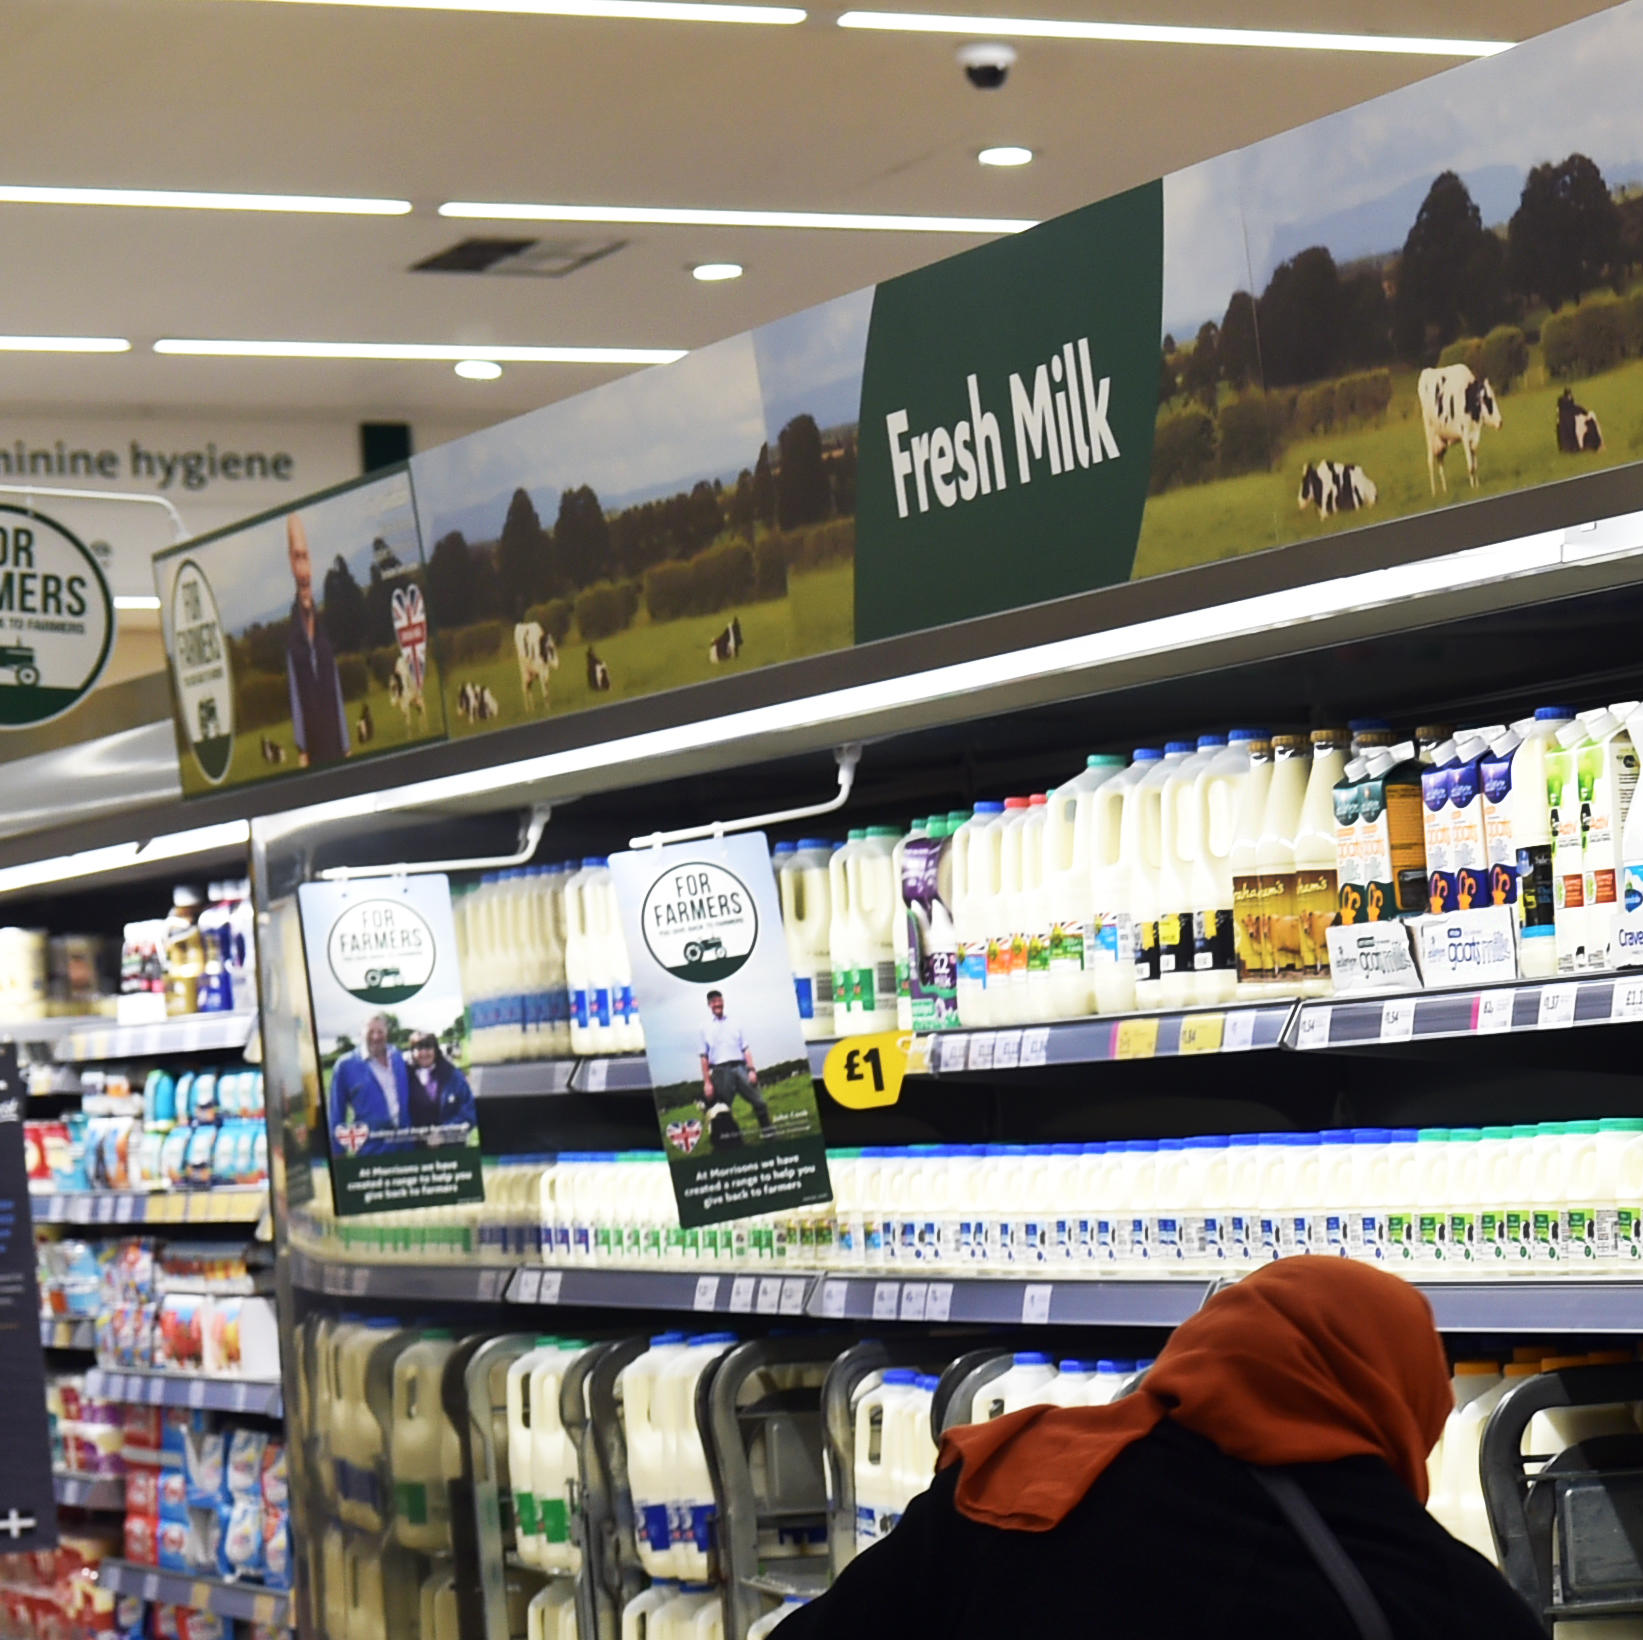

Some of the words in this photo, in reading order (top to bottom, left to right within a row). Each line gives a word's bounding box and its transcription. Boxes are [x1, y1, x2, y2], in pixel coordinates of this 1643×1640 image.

[886, 373, 1007, 518] Fresh
[1009, 337, 1121, 484] Milk
[131, 439, 295, 490] hygiene
[675, 872, 712, 898] FOR
[362, 908, 394, 929] FOR
[653, 892, 743, 928] FARMERS
[340, 928, 422, 953] FARMERS
[844, 1048, 885, 1092] £1
